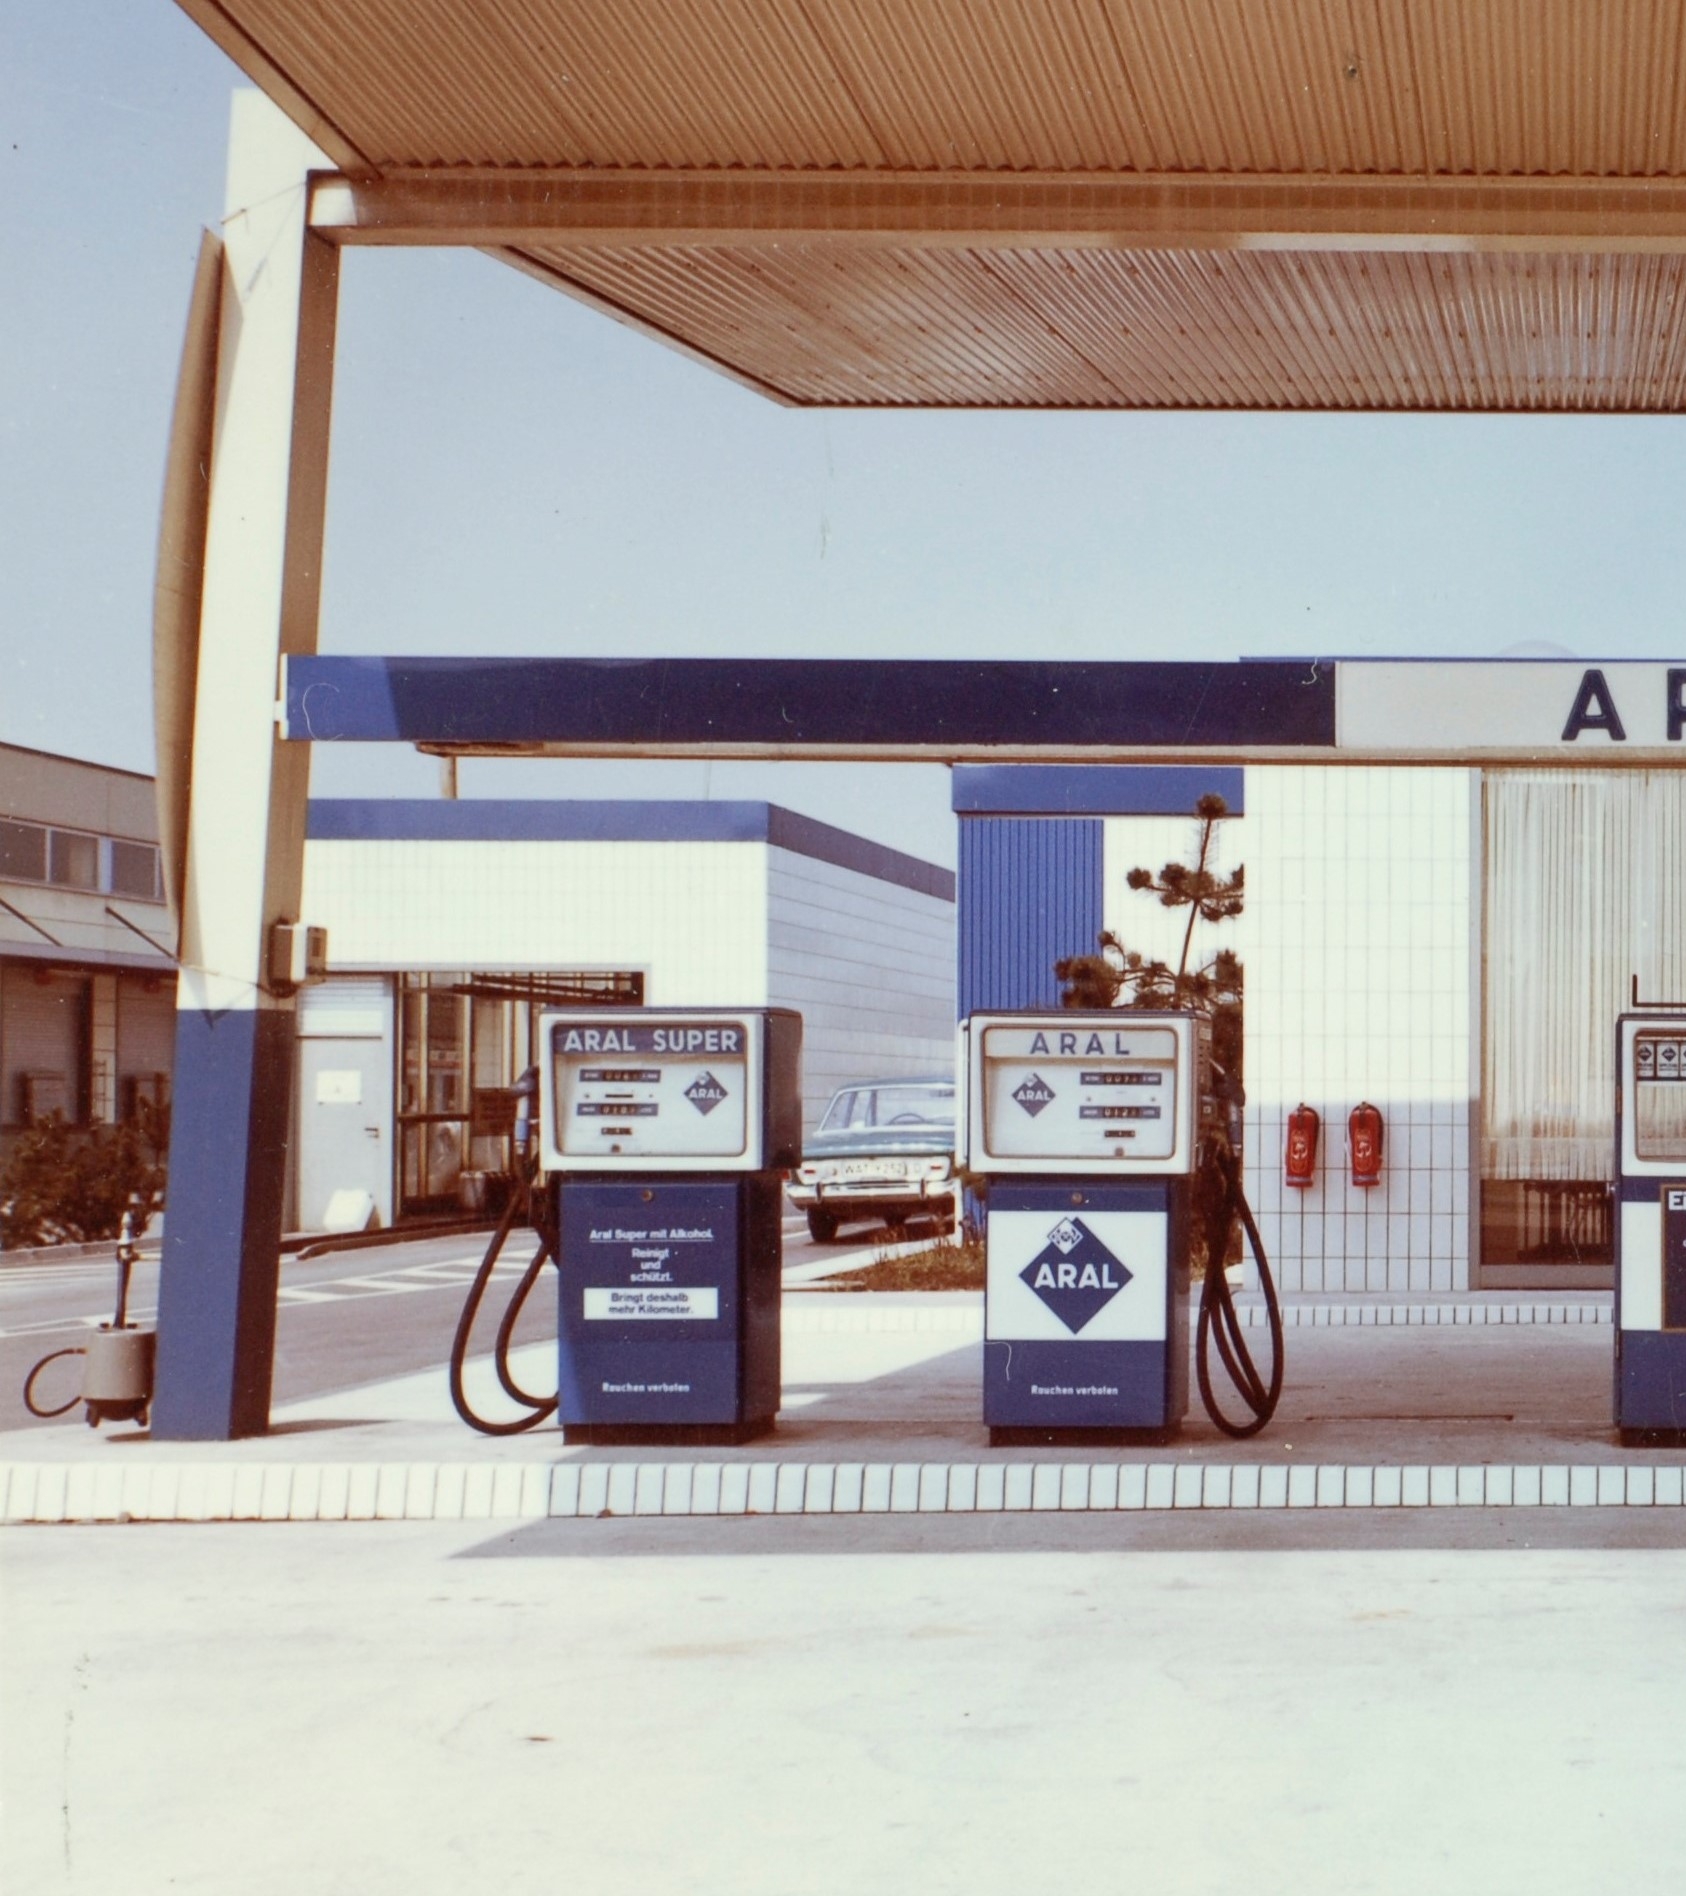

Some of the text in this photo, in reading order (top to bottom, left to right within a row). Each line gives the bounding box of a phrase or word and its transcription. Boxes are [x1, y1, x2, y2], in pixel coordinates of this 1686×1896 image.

[563, 1029, 738, 1051] ARAL SUPER
[1030, 1032, 1130, 1055] ARAL
[688, 1088, 724, 1099] ARAL
[1016, 1090, 1051, 1101] ARAL
[589, 1228, 714, 1242] Aral Super mit Alkohol.
[631, 1248, 670, 1259] Reinigt
[640, 1260, 661, 1270] und
[630, 1272, 674, 1282] schützt.
[1034, 1263, 1119, 1289] ARAL
[611, 1293, 688, 1304] Bringt deshalb
[608, 1305, 694, 1314] mehr Kilometer.
[602, 1382, 690, 1392] Rauchen verboten
[1031, 1385, 1119, 1395] Rauchen verboten
